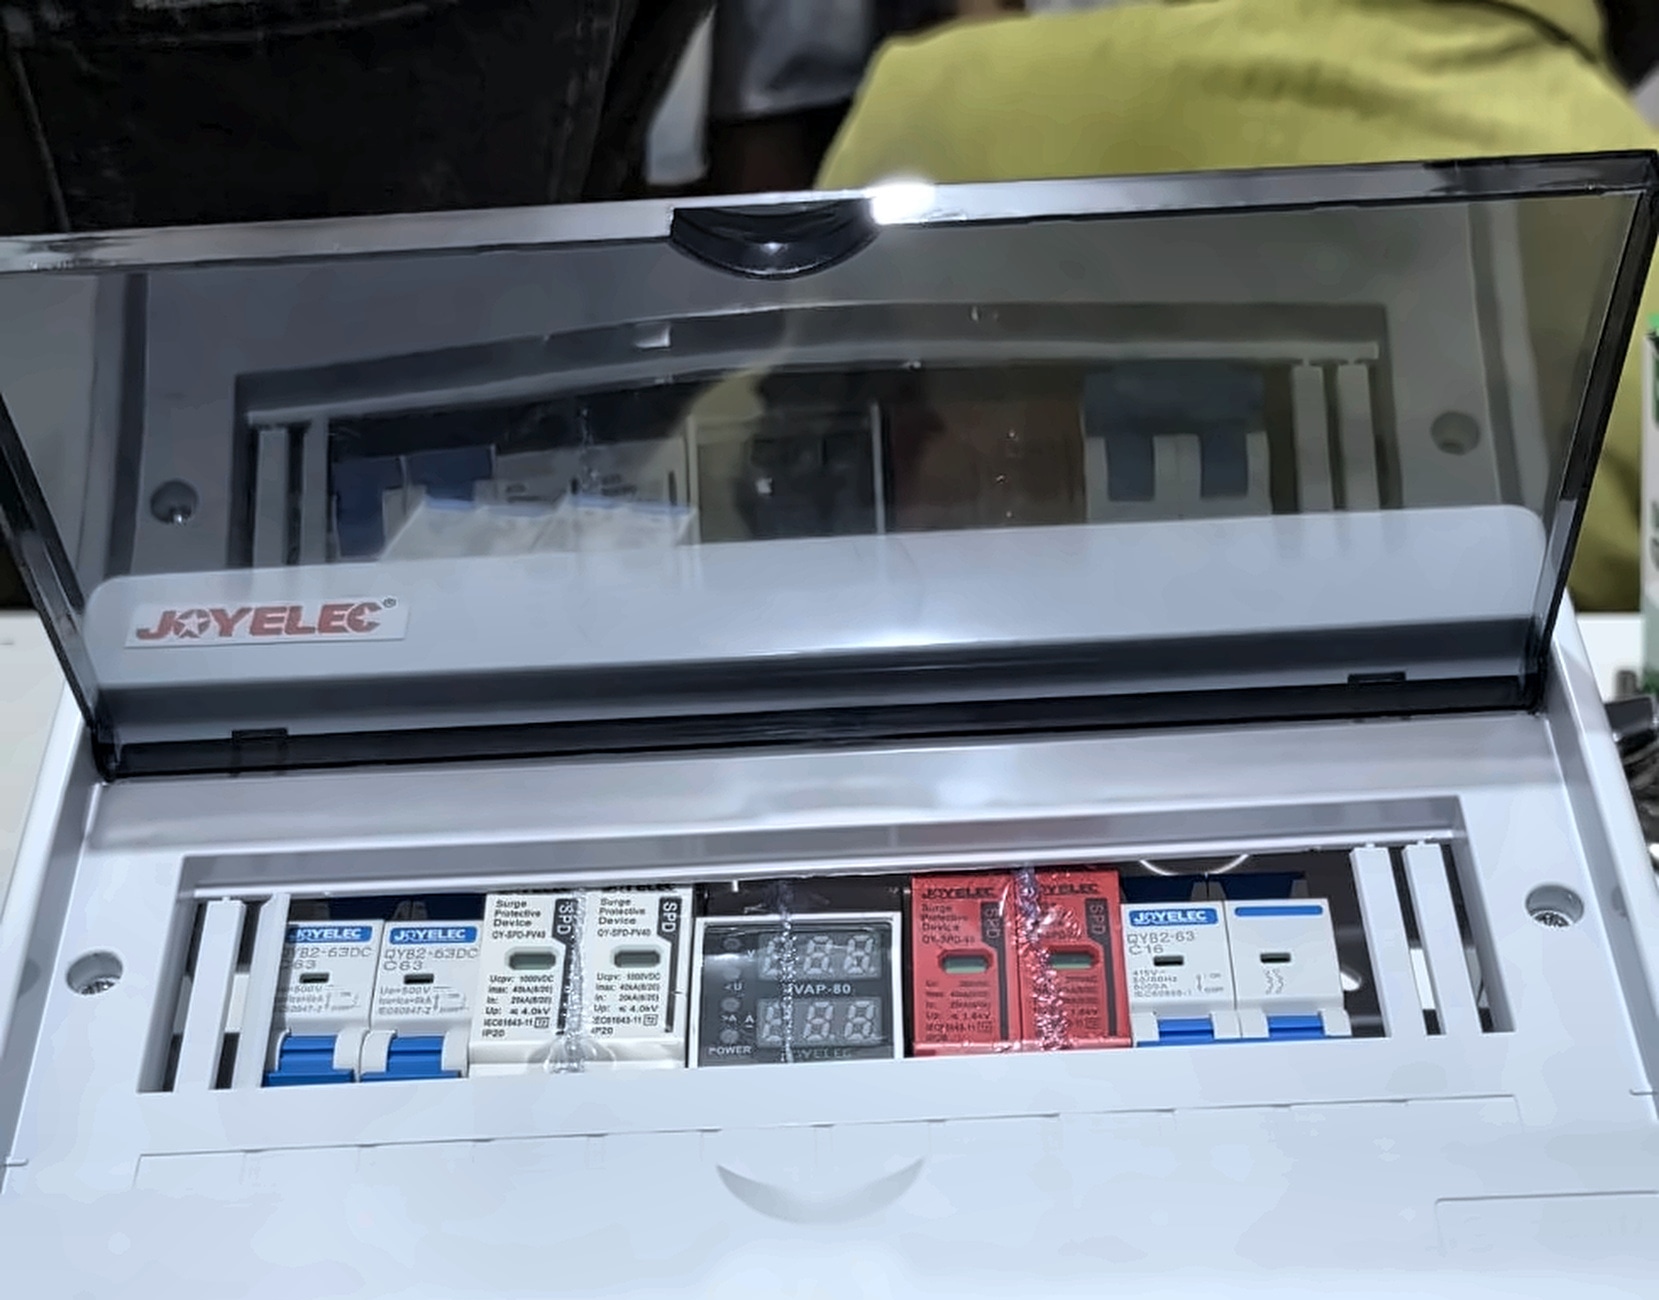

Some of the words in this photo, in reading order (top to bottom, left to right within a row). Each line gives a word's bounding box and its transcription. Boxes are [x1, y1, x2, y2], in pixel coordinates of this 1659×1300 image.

[136, 602, 382, 640] JOYELEC
[497, 901, 527, 910] Surge
[600, 899, 631, 908] Surge
[494, 909, 541, 918] Protective
[599, 907, 646, 916] Protective
[661, 901, 678, 932] SPD
[494, 919, 532, 927] Device
[557, 903, 573, 935] SPD
[599, 917, 636, 925] Device
[983, 908, 1002, 939] SPD
[1089, 904, 1107, 935] SPD
[1134, 911, 1207, 925] JOYELEC
[394, 928, 467, 943] JOYELEC
[1129, 944, 1164, 954] C16
[383, 960, 424, 971] C63
[708, 1045, 752, 1056] POWER
